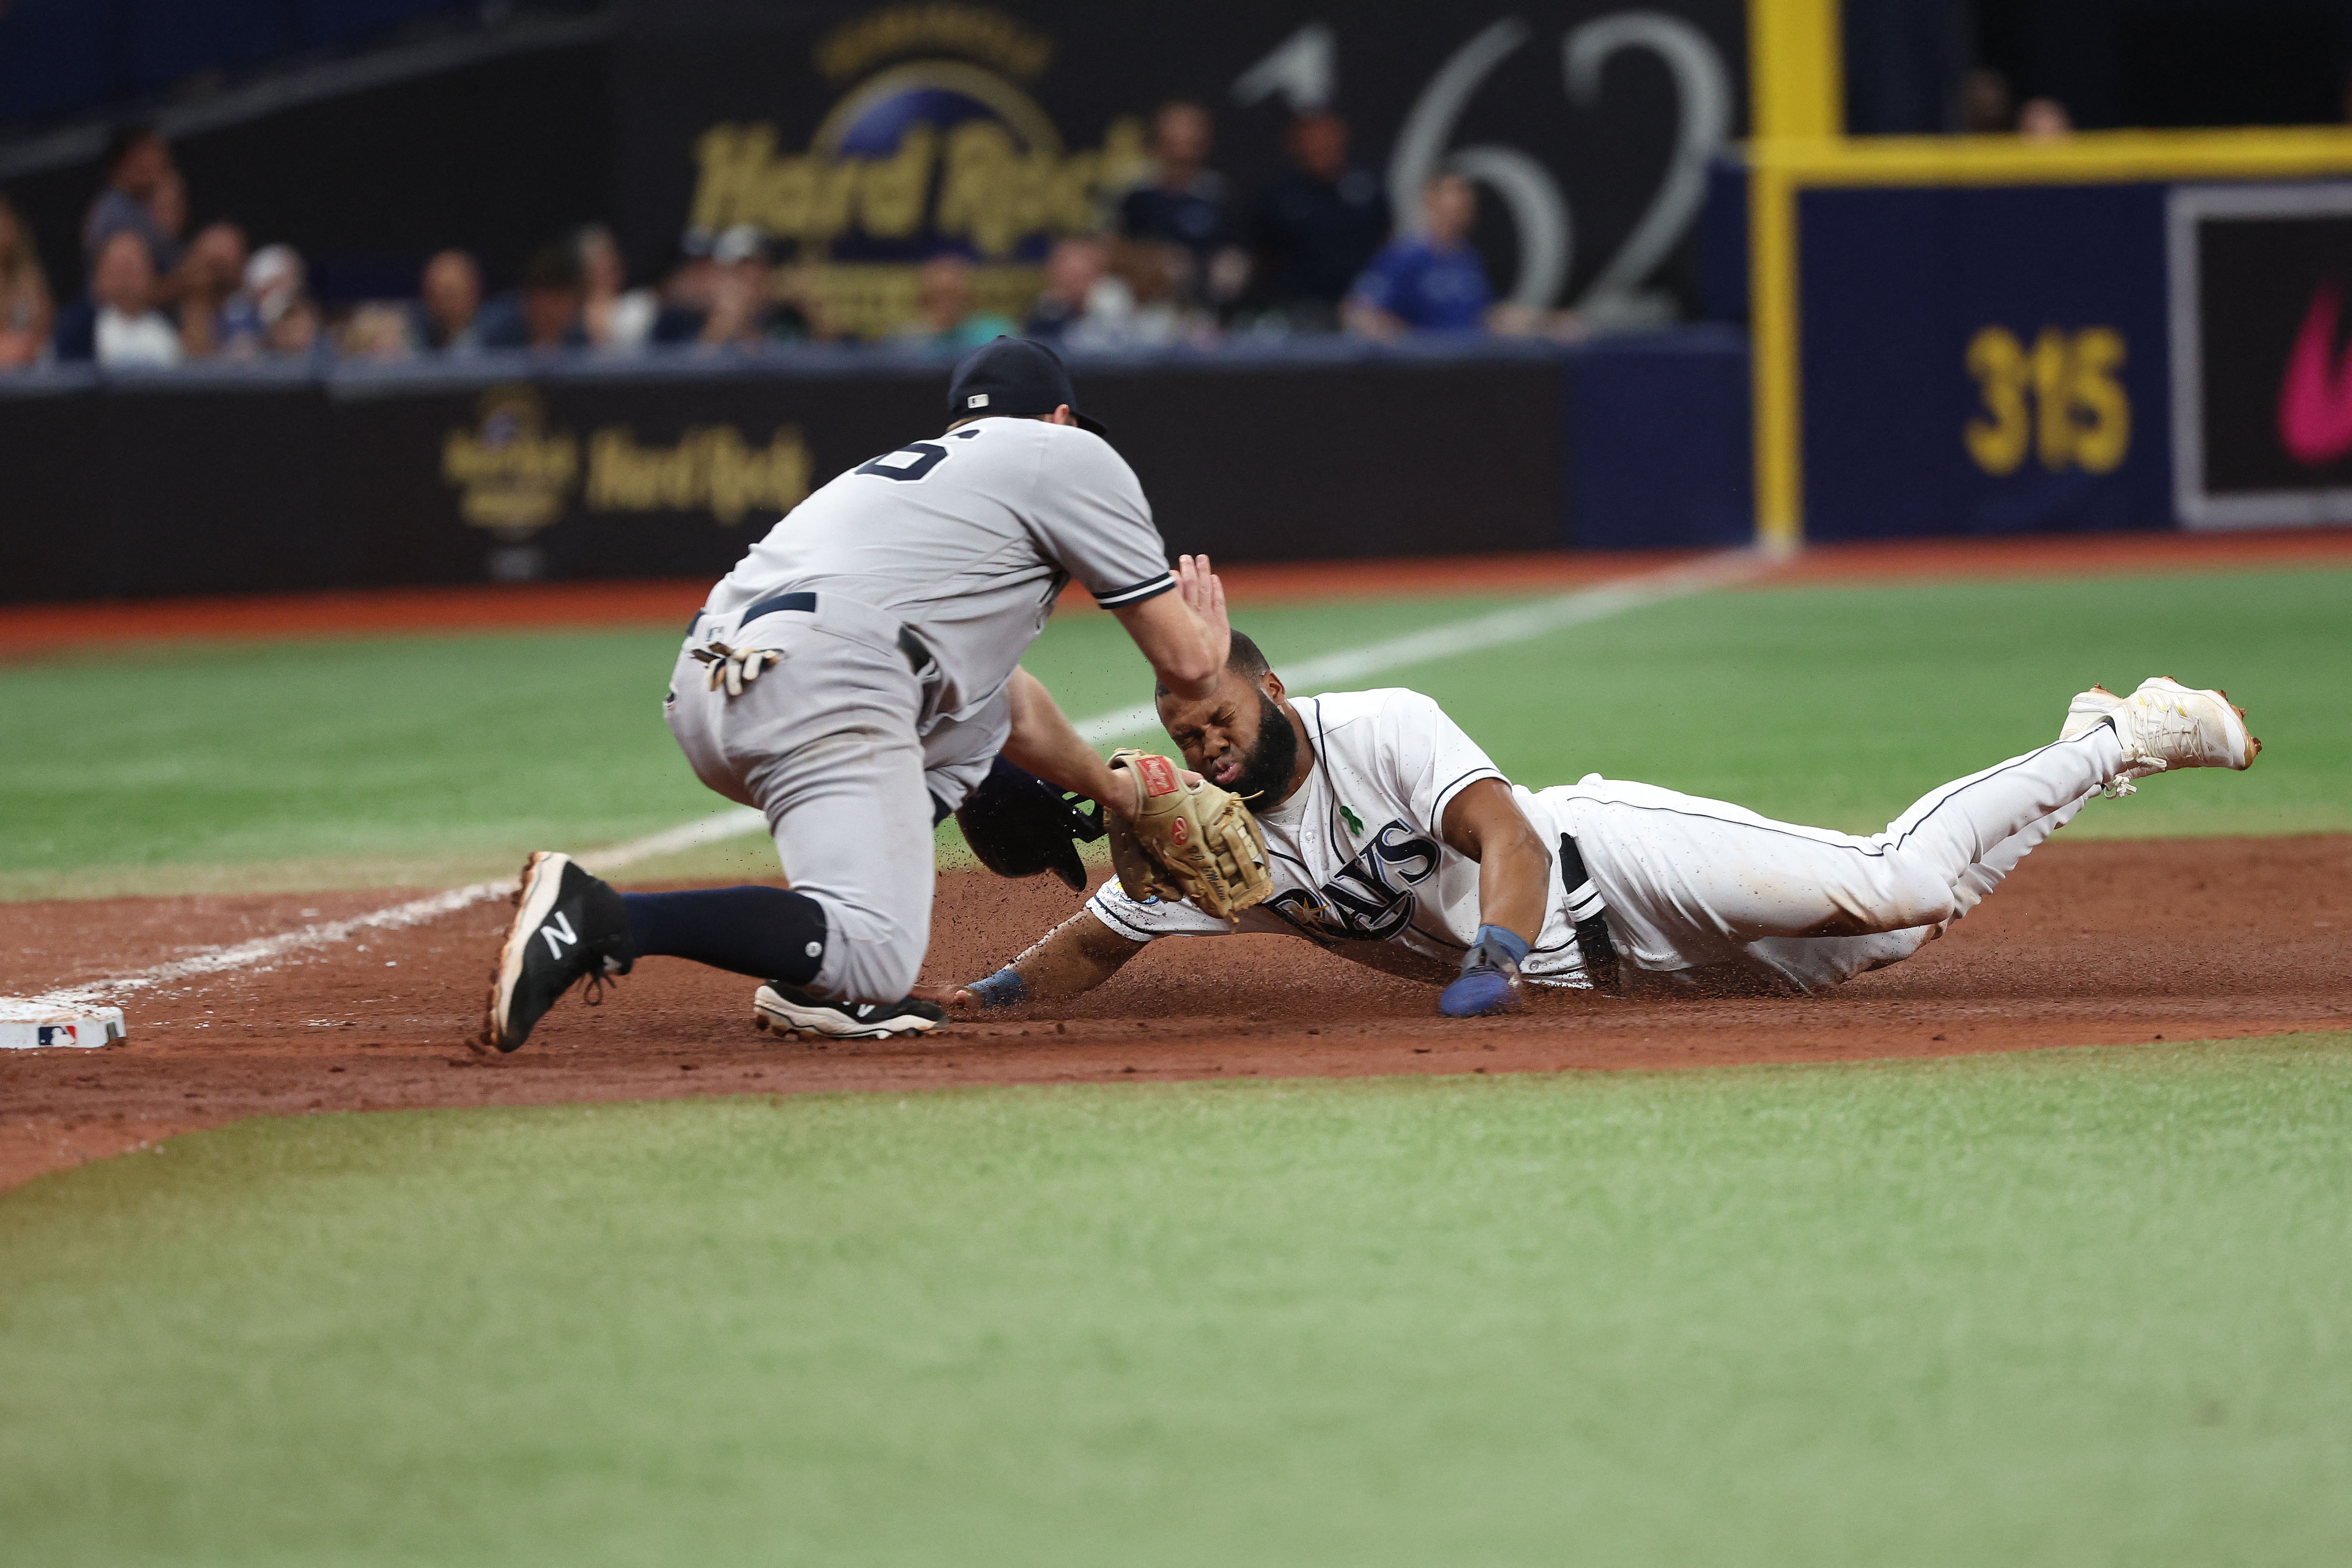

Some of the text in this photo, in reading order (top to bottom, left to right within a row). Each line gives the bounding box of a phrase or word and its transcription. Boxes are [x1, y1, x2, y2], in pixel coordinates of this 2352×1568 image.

[1964, 324, 2133, 478] 315
[539, 910, 578, 961] N
[1263, 817, 1442, 948] RAYS
